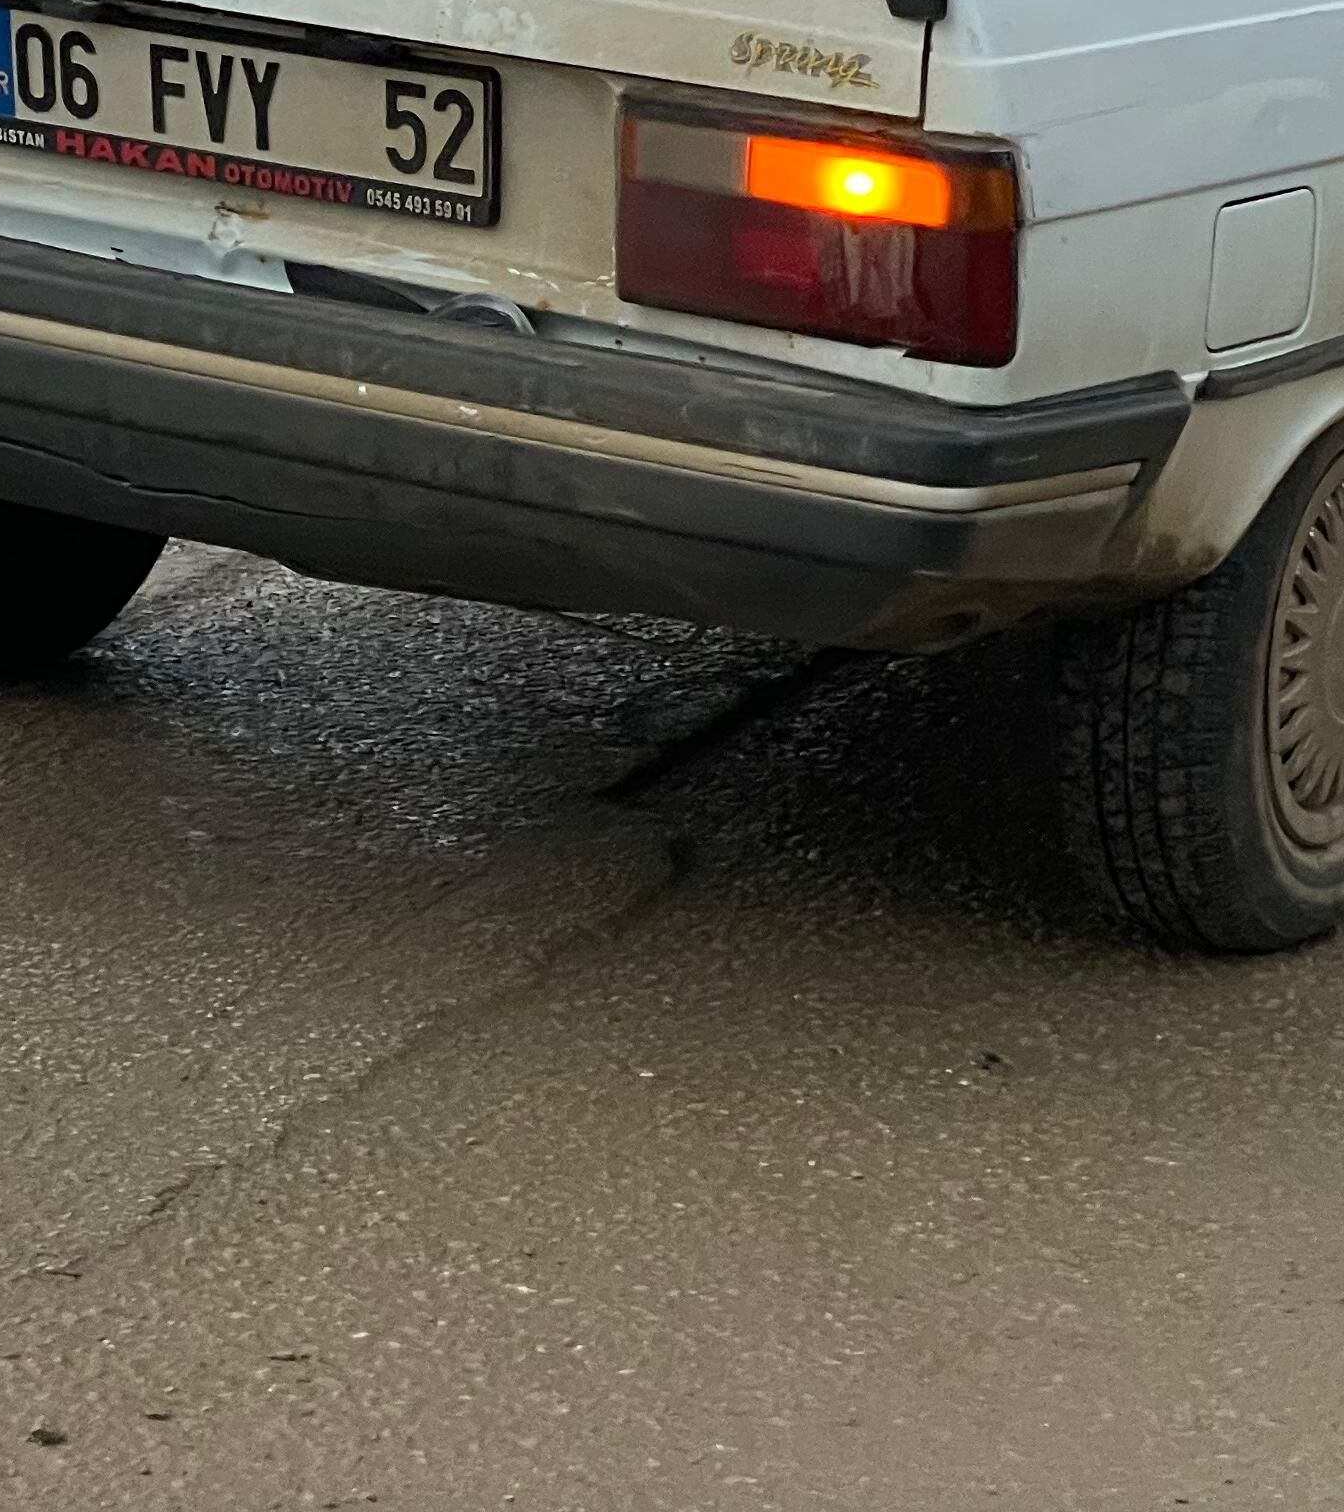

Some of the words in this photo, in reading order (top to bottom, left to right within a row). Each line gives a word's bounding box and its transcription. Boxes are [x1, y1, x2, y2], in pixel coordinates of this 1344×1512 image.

[15, 23, 99, 120] 06
[149, 43, 280, 151] FVY
[385, 79, 475, 185] 52
[56, 129, 217, 181] HAKAN
[367, 188, 401, 210] 0545
[405, 195, 431, 215] 493
